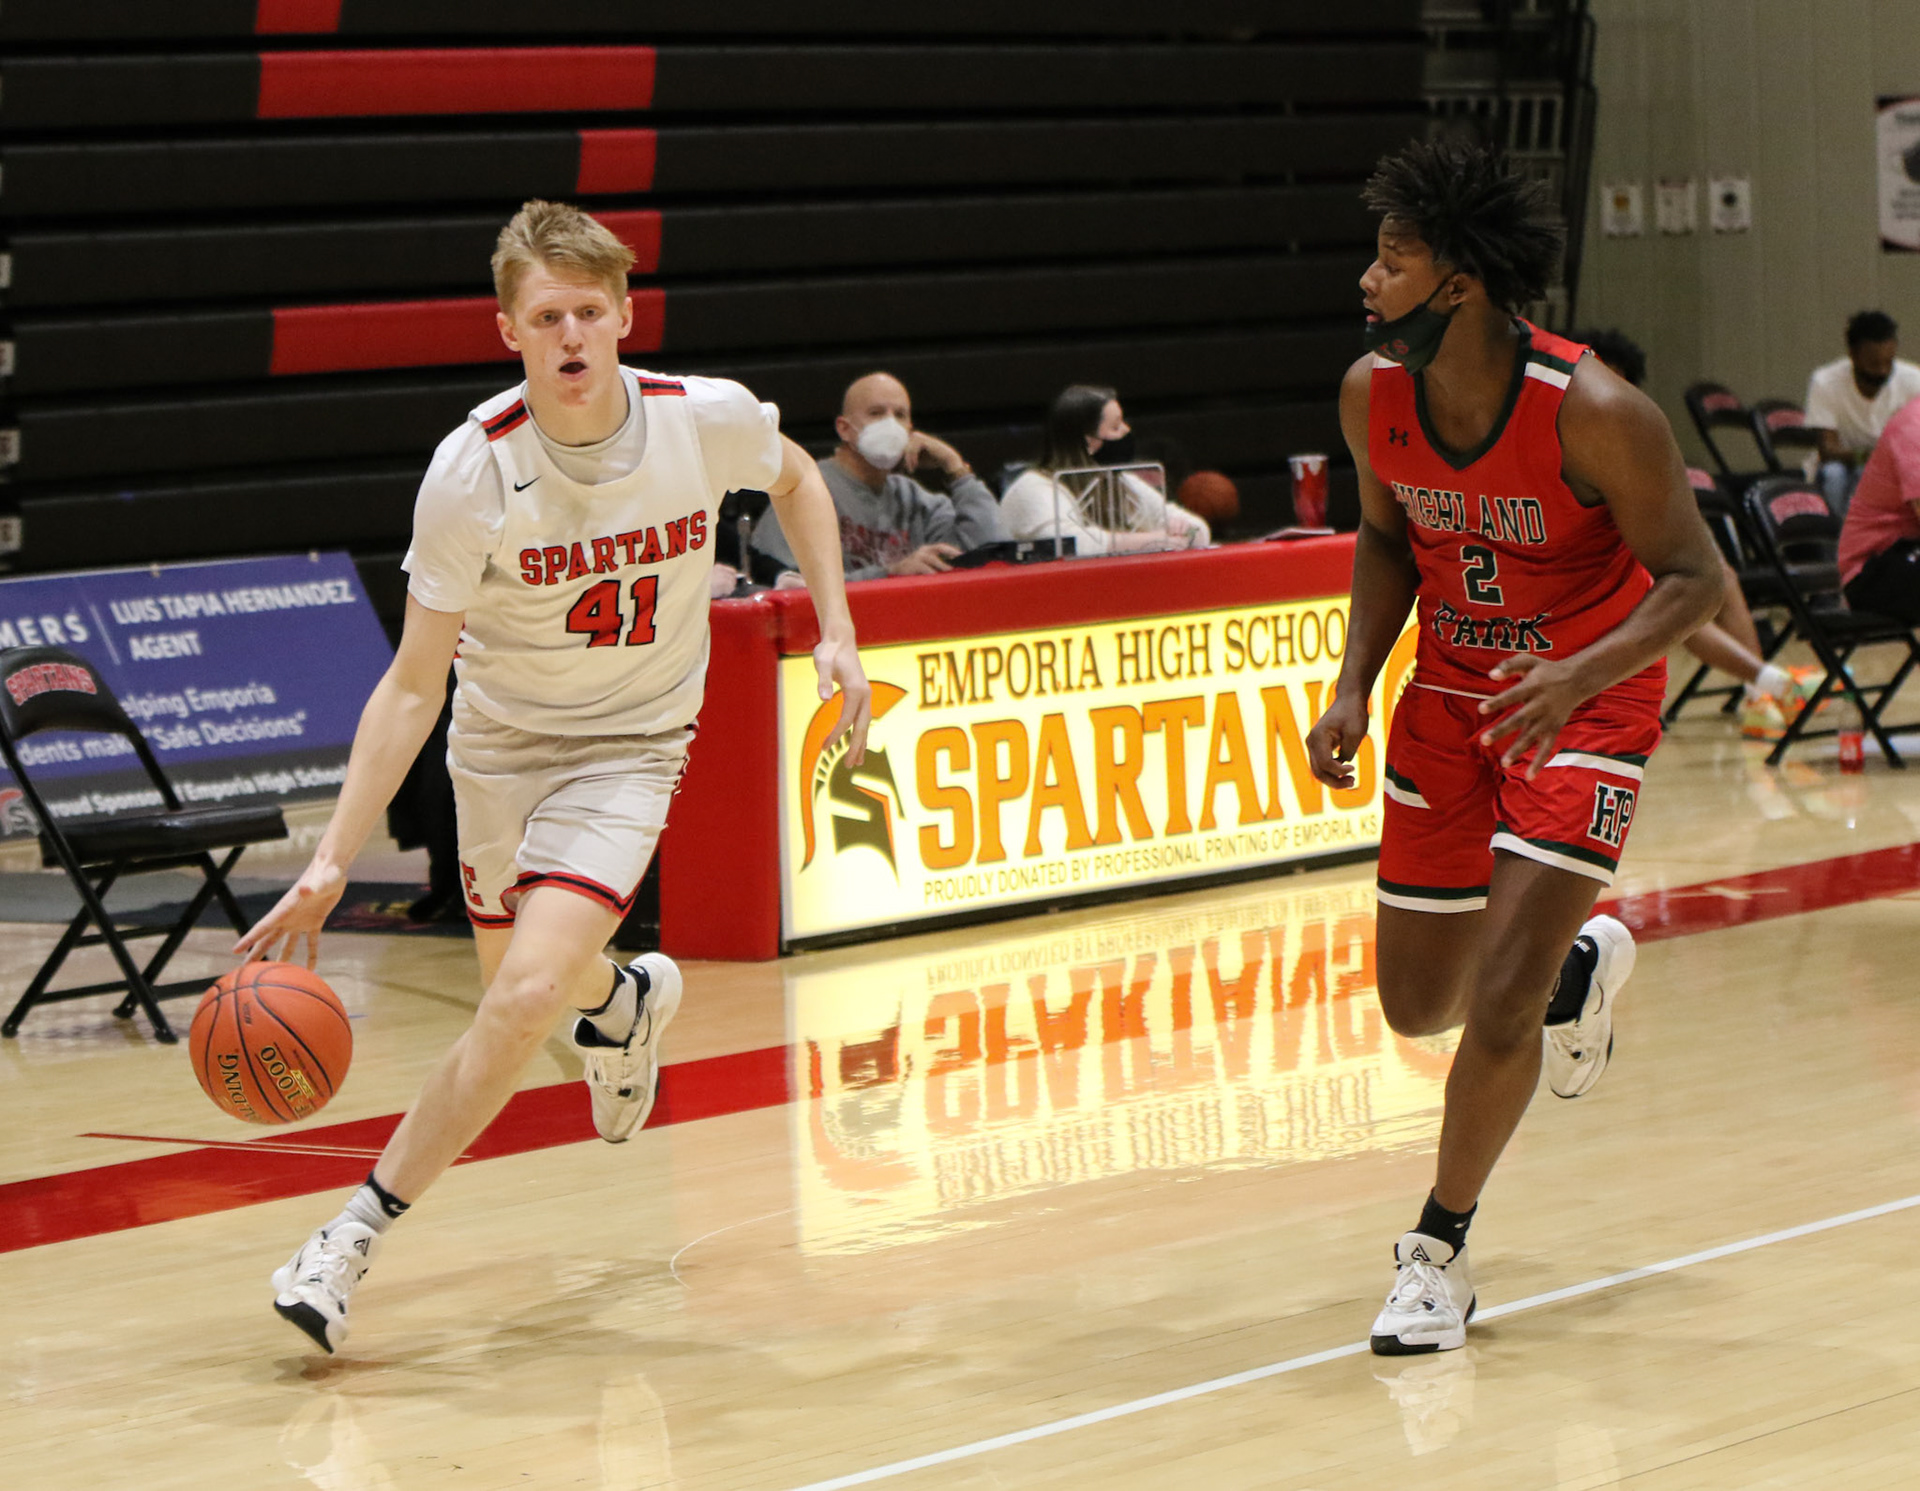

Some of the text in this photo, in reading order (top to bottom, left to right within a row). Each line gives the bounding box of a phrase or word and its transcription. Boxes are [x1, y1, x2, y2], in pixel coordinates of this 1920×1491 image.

[1391, 479, 1547, 545] HIGHLAND
[519, 510, 707, 586] SPARTANS
[1460, 543, 1504, 606] 2
[110, 579, 356, 625] LUIS TAPIA HERNANDEZ
[565, 574, 659, 648] 41
[1432, 599, 1553, 652] PARK
[128, 631, 202, 661] AGENT
[917, 606, 1349, 710] EMPORIA HIGH SCHOO
[119, 680, 277, 721] elping Emporia
[82, 733, 136, 758] mak
[916, 681, 1377, 871] SPARTANS
[1586, 780, 1636, 849] HP
[923, 868, 995, 905] PROUDLY
[998, 861, 1067, 893] DONATED
[1071, 855, 1092, 882] BY
[1094, 839, 1202, 878] PROFESSIONAL
[1205, 830, 1269, 860] PRINTING
[1272, 827, 1290, 851] OF
[1361, 813, 1379, 837] KS
